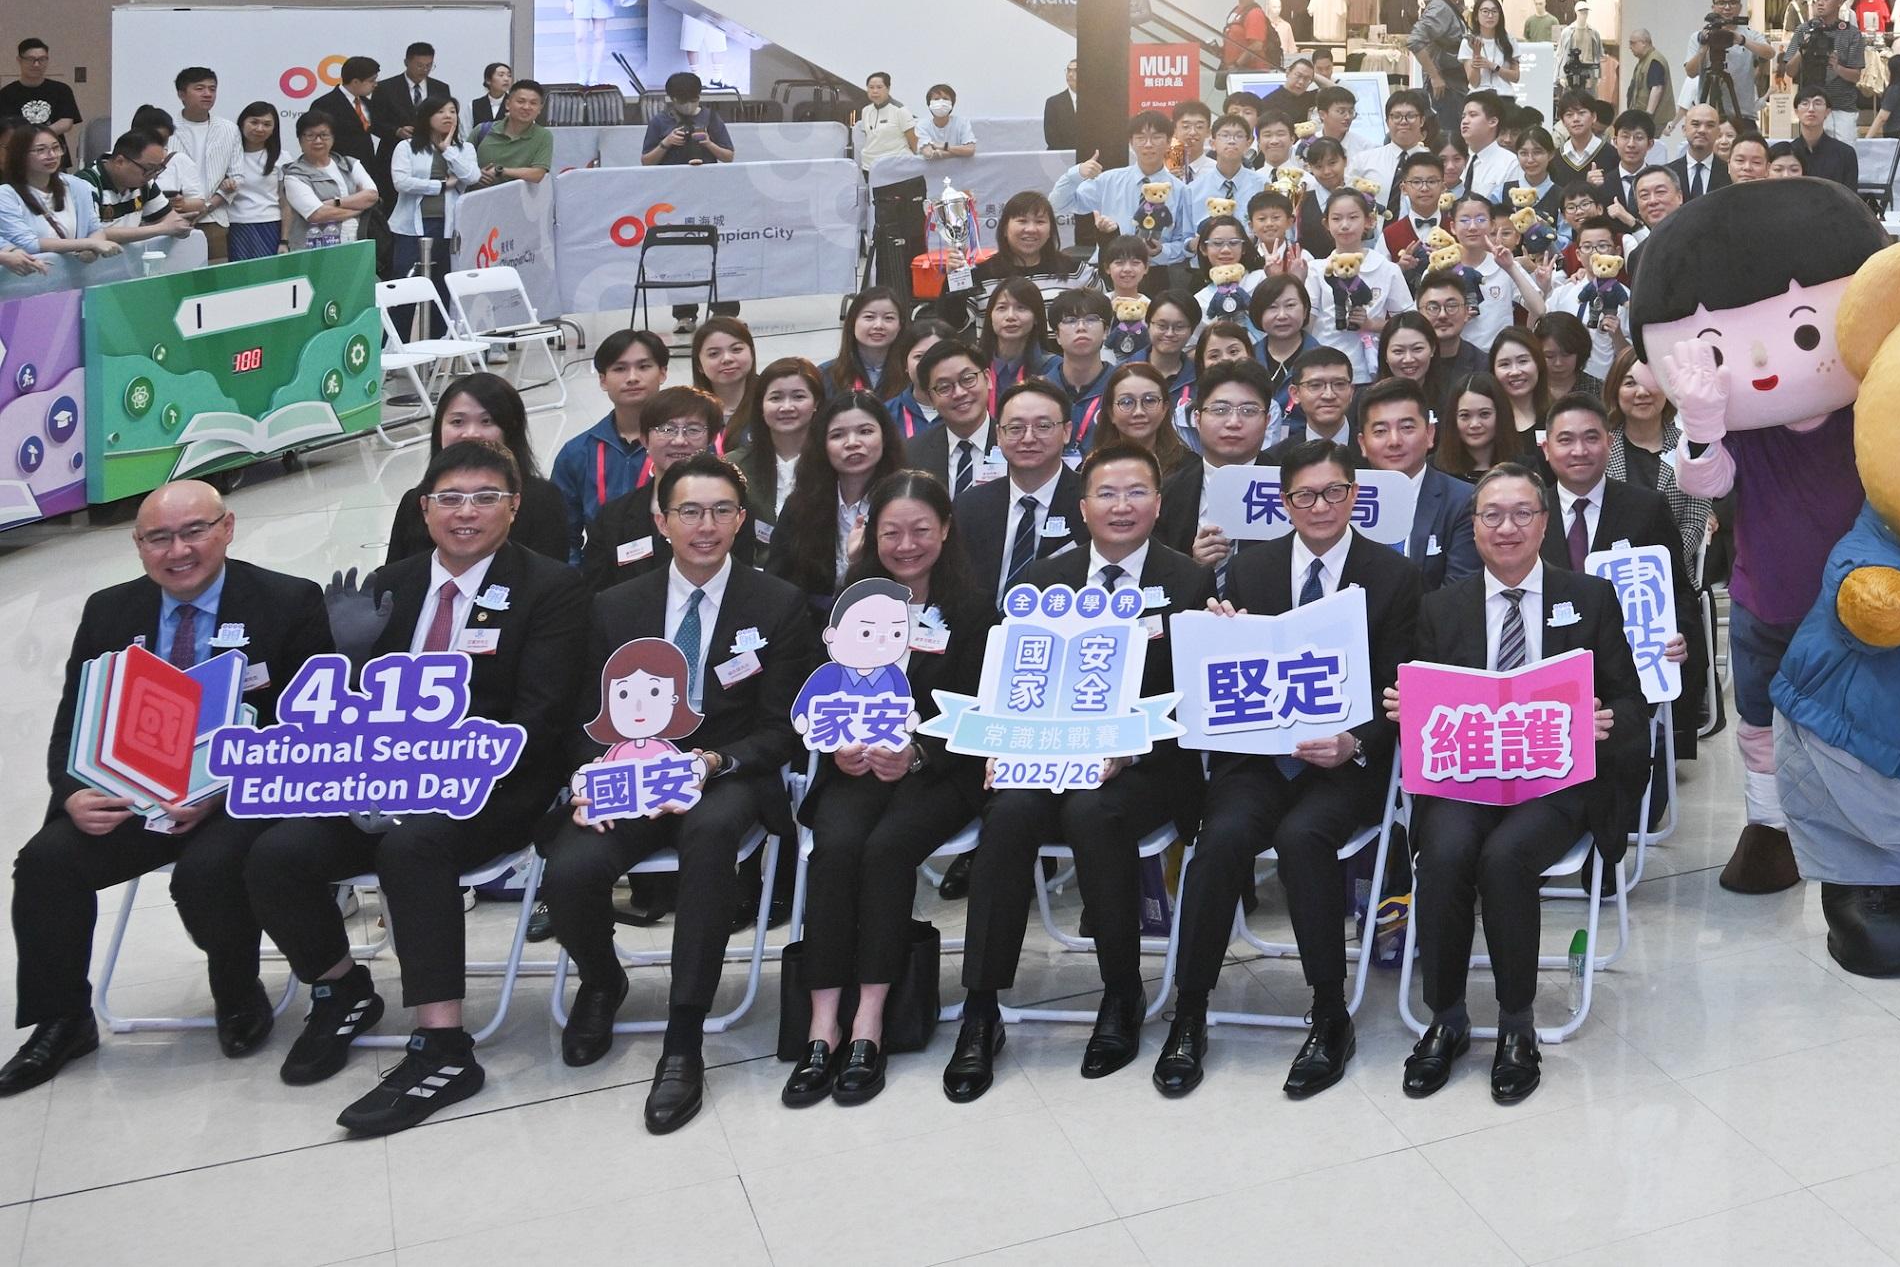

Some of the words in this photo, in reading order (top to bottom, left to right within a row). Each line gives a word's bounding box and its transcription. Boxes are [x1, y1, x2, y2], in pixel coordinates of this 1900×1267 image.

[1139, 56, 1188, 76] MUJI
[1144, 77, 1183, 87] 無印良品
[763, 226, 794, 241] City
[1242, 480, 1379, 529] 保局
[1012, 593, 1137, 614] 全港學界
[1007, 634, 1053, 711] 國家
[1070, 634, 1117, 711] 安全
[1208, 651, 1343, 727] 堅定
[291, 663, 459, 725] 4.15
[809, 695, 910, 748] 家安
[981, 723, 1120, 751] 常識挑戰賽
[1428, 705, 1567, 775] 維護
[221, 734, 363, 765] National
[370, 733, 512, 767] Security
[241, 776, 409, 807] Education
[418, 776, 482, 807] Day
[584, 757, 698, 820] 國安
[995, 761, 1100, 789] 2025/26
